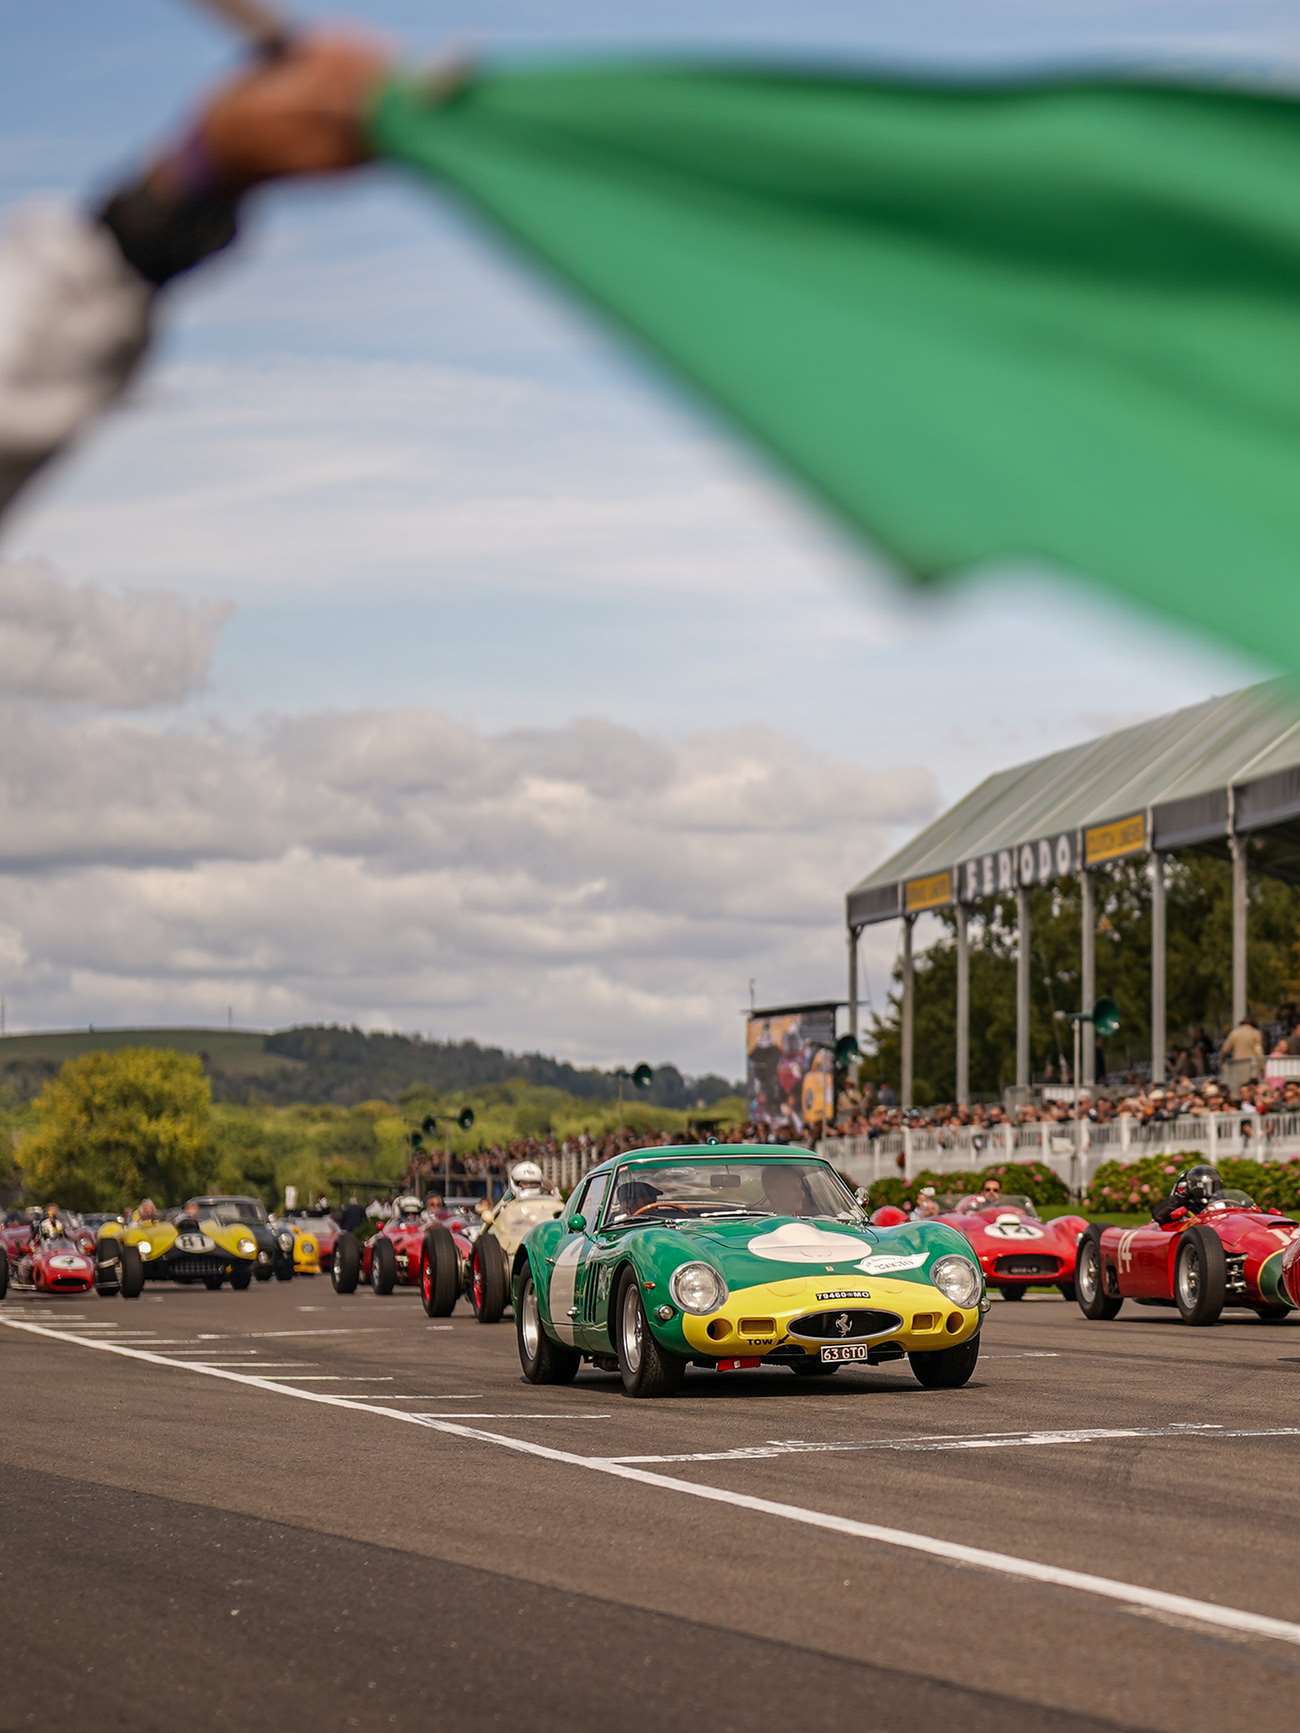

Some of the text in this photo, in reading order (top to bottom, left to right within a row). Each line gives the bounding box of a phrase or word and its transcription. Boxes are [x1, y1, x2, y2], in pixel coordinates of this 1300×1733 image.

[966, 834, 1071, 901] FERODO
[1118, 1231, 1138, 1274] 14
[747, 1338, 773, 1346] TOW
[823, 1346, 865, 1360] 63 GTO
